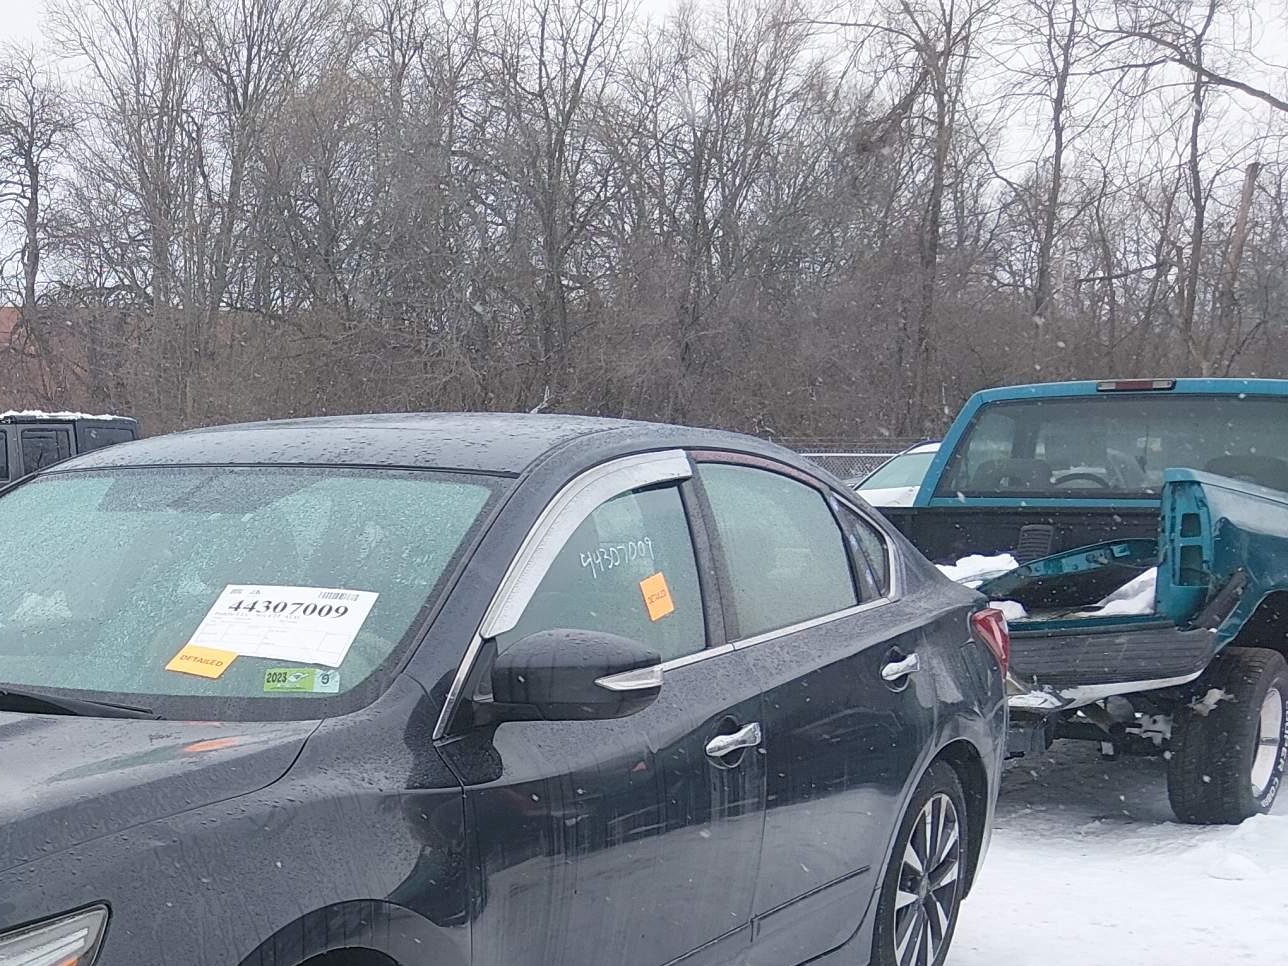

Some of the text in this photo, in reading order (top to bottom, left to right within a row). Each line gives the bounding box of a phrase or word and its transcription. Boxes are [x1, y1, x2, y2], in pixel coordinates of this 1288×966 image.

[580, 536, 655, 579] 44307009
[228, 599, 349, 619] 44307009
[179, 654, 224, 668] DETAILED
[266, 671, 330, 685] 2023 9
